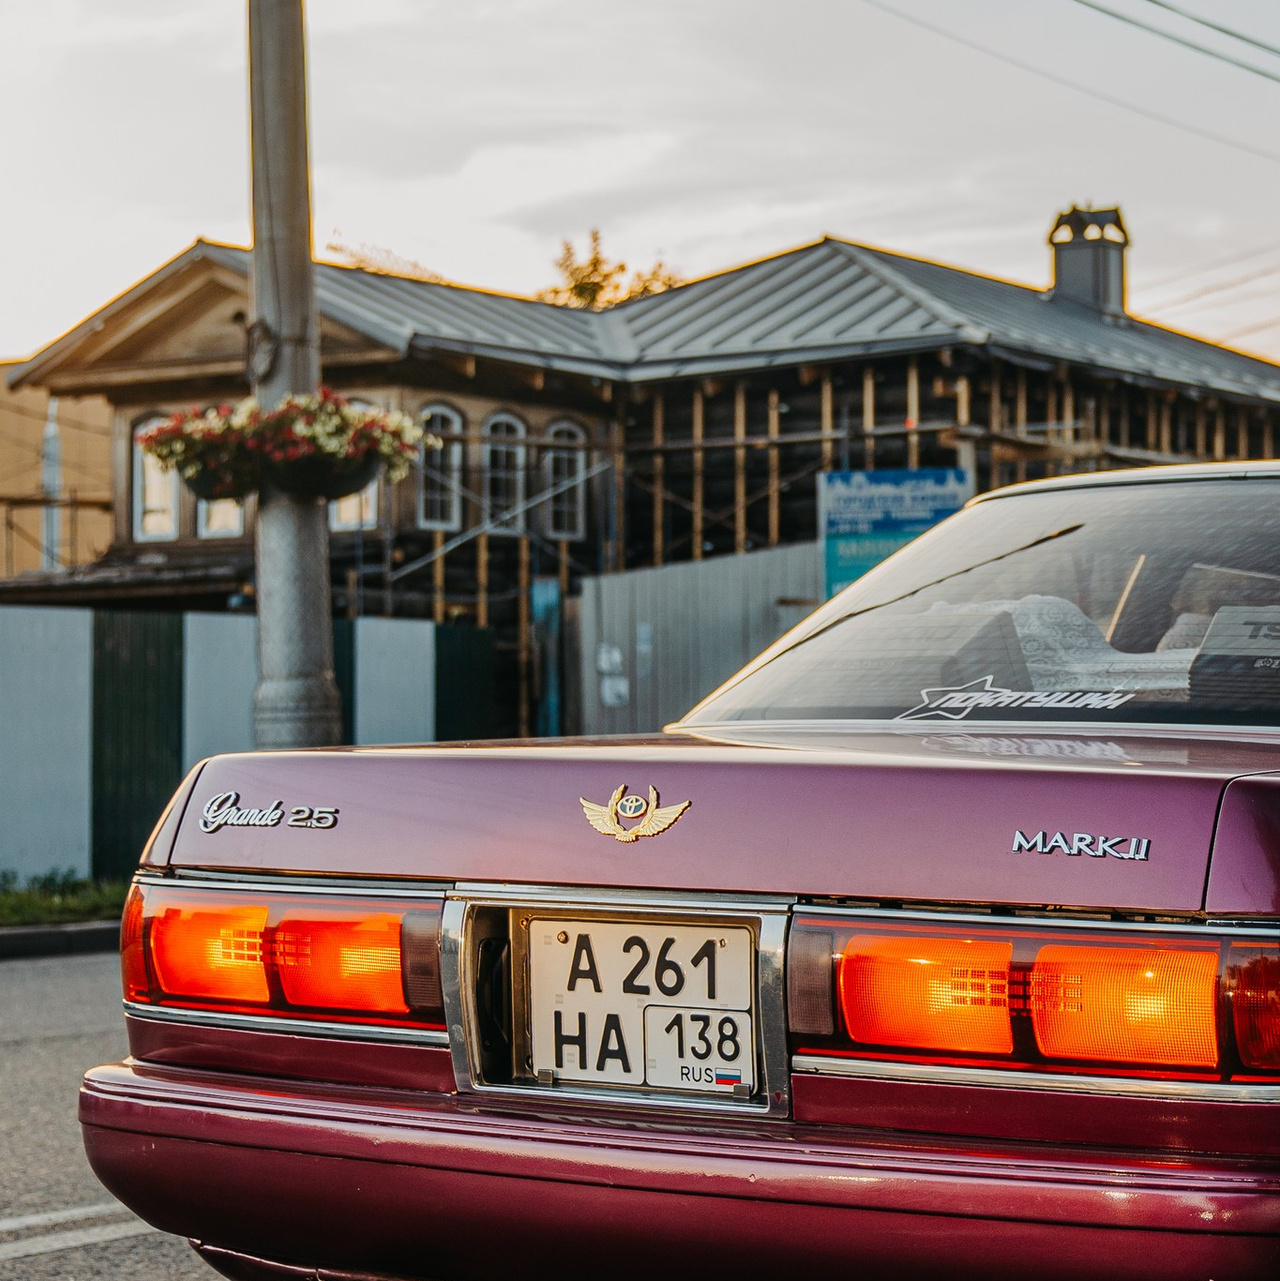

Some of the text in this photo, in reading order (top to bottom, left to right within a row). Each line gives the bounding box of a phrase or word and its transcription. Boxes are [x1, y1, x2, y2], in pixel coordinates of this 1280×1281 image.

[928, 690, 1136, 710] ПОКАТУШКИ
[199, 790, 285, 834] Grande
[622, 935, 717, 1000] 261
[664, 1013, 740, 1062] 138
[680, 1066, 714, 1083] RUS
